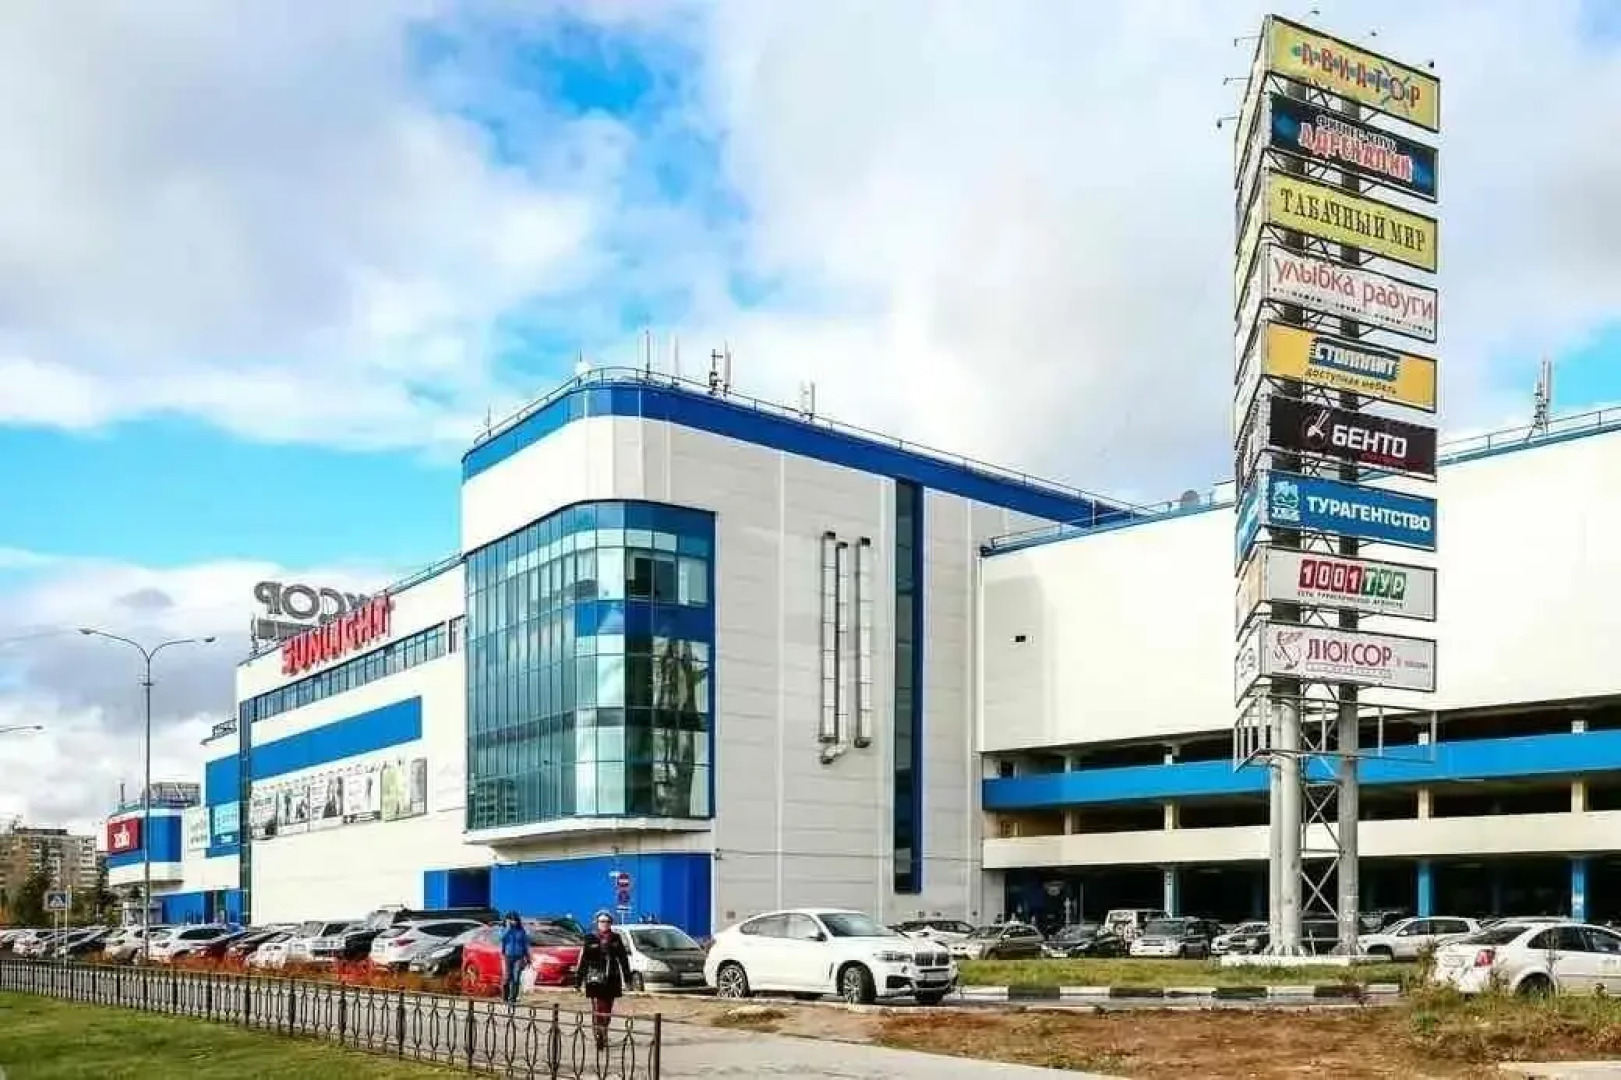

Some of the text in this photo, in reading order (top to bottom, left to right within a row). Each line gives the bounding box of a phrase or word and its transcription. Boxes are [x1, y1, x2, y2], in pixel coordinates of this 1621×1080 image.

[1281, 188, 1425, 252] ТАБАЧНЫЙ МИР
[1363, 281, 1433, 320] радуги
[1332, 424, 1407, 458] БЕНТО
[1307, 496, 1430, 531] ТУРАГЕНТСТВО
